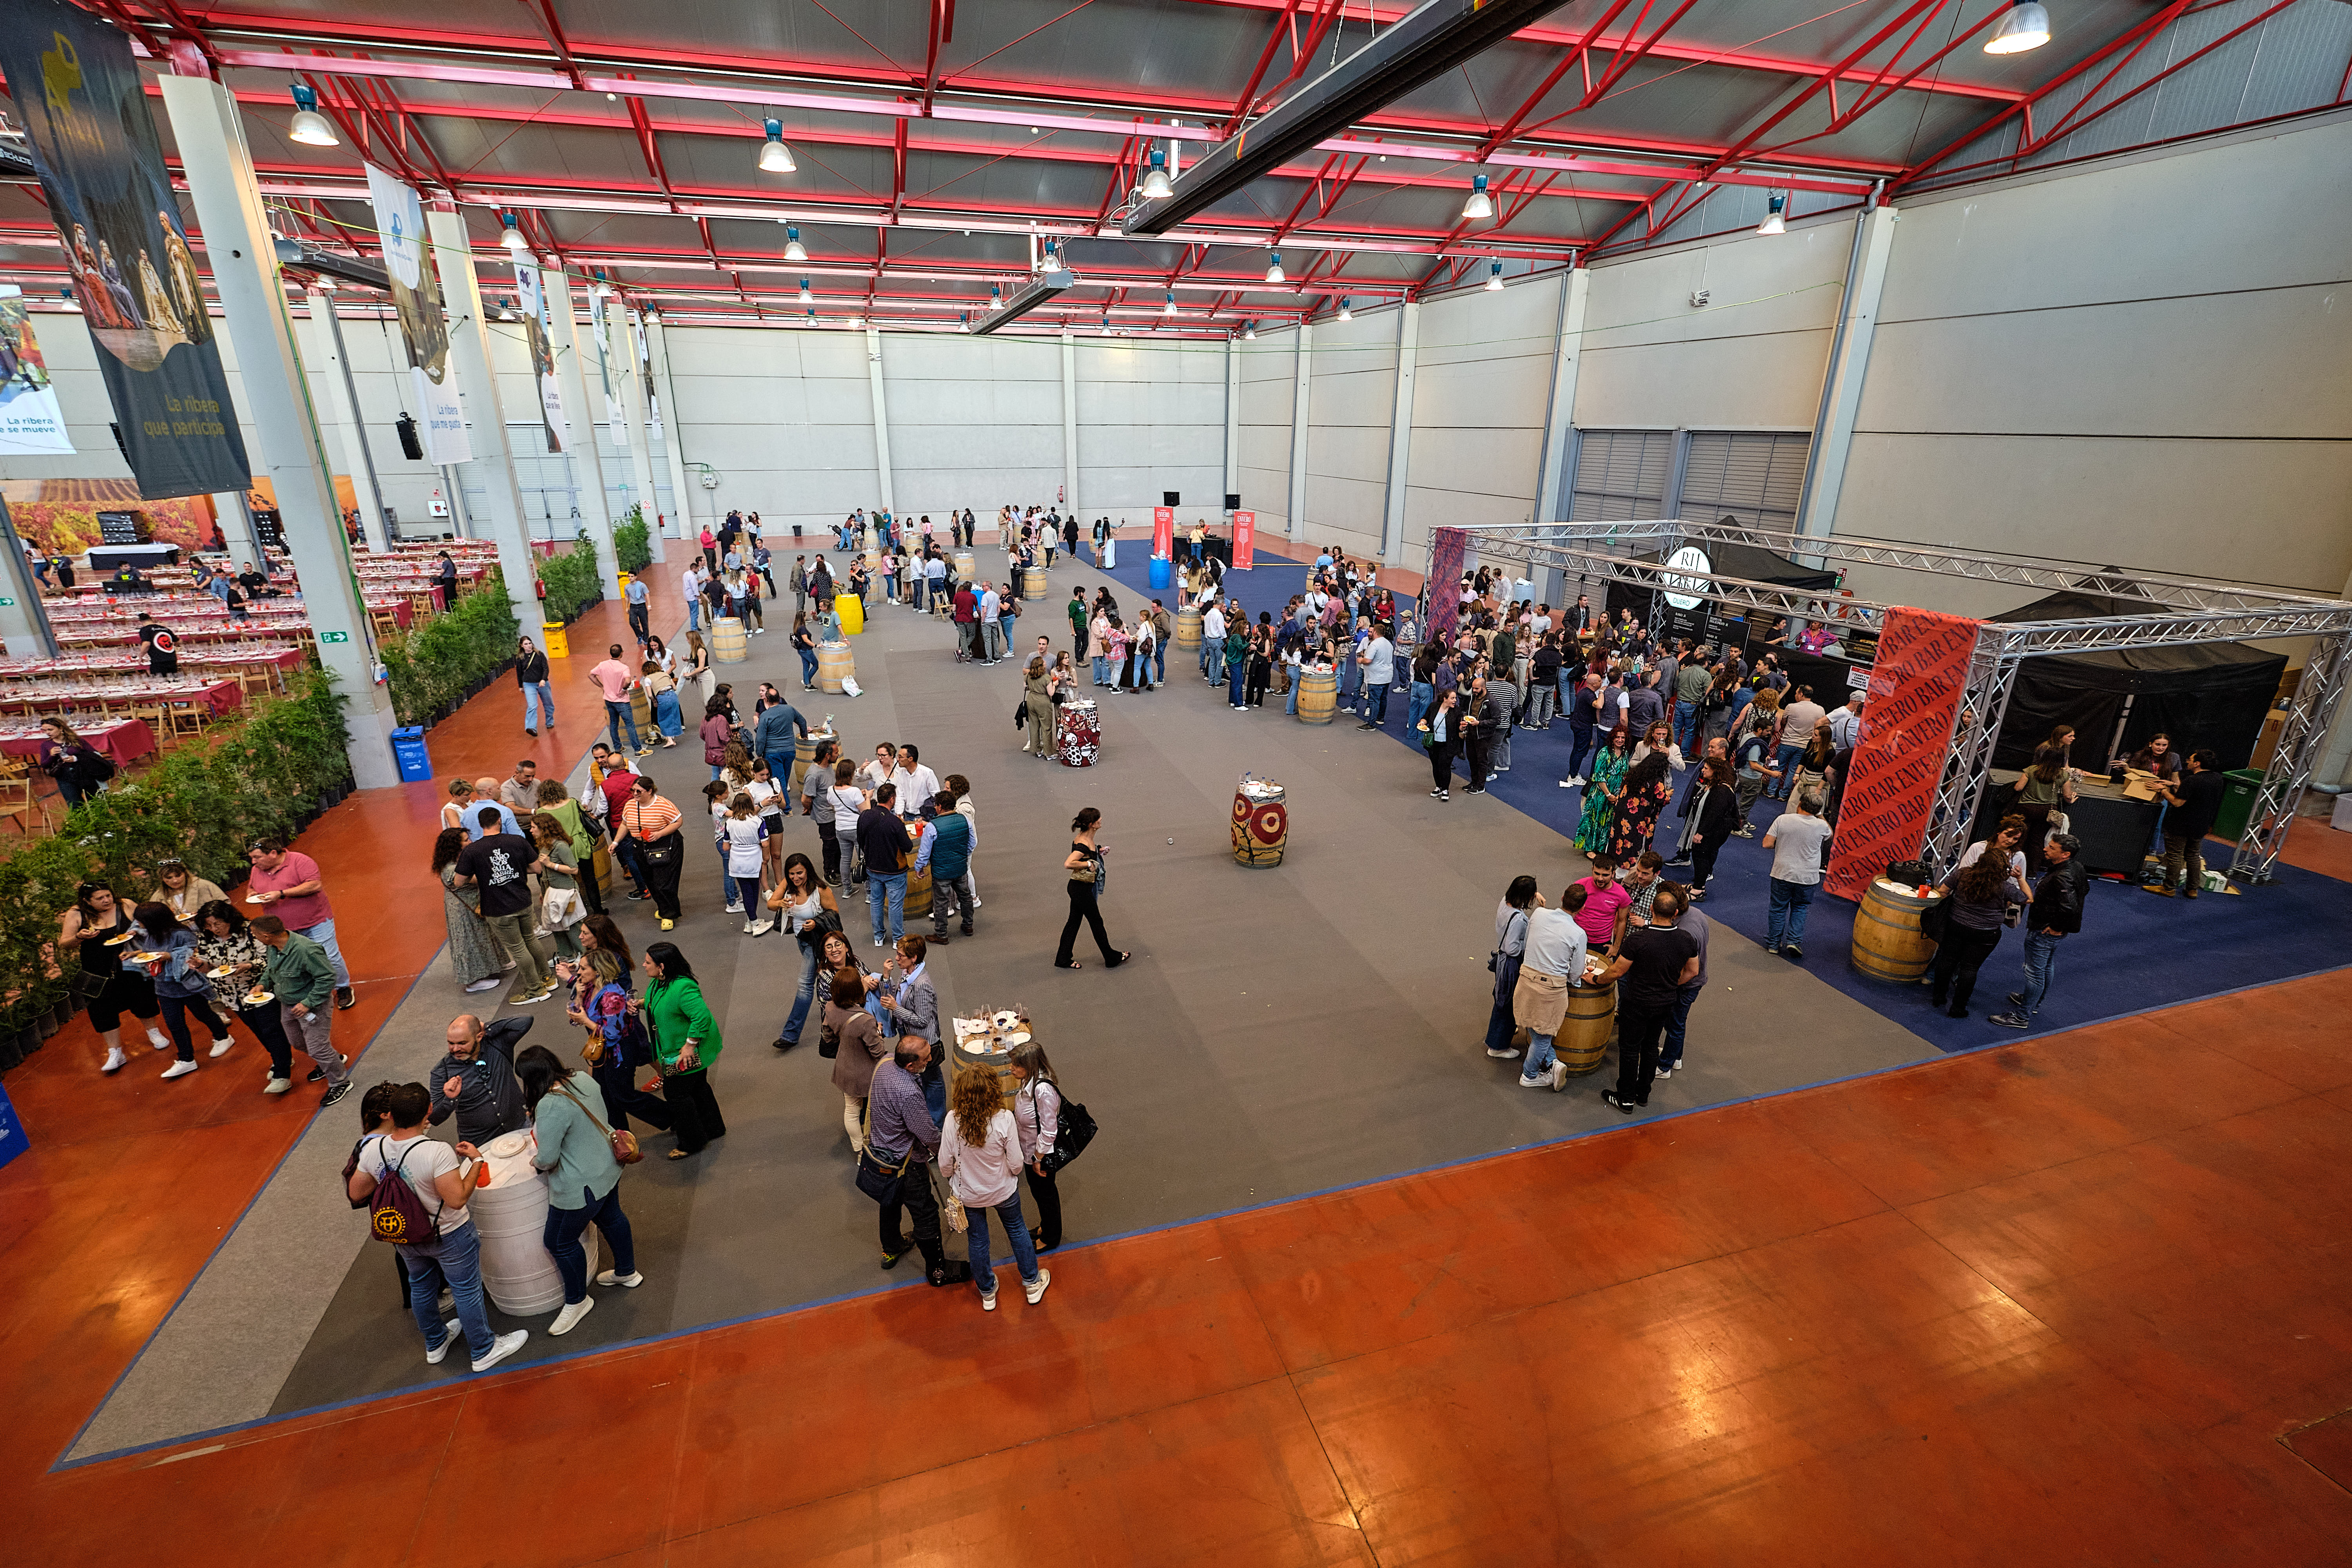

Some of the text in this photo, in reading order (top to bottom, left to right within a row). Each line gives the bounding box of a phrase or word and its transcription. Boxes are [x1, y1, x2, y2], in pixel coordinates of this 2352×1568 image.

[165, 394, 220, 413] La ribera
[437, 405, 458, 414] La ribera
[143, 417, 225, 439] que participa
[431, 420, 440, 430] que
[448, 419, 461, 430] gusta
[1673, 597, 1690, 606] DUERO
[1884, 625, 1917, 656] BAR
[1913, 640, 1947, 671] BAR
[1864, 695, 1917, 738] ENVERO
[1914, 675, 1951, 706] BAR
[1866, 743, 1898, 771] BAR
[1893, 711, 1949, 755] ENVERO
[1867, 777, 1900, 804] BAR
[1895, 746, 1946, 789] ENVERO
[1847, 810, 1901, 848] ENVERO
[1897, 795, 1928, 823] BAR
[1826, 866, 1855, 892] BAR
[1849, 843, 1904, 880] ENVERO
